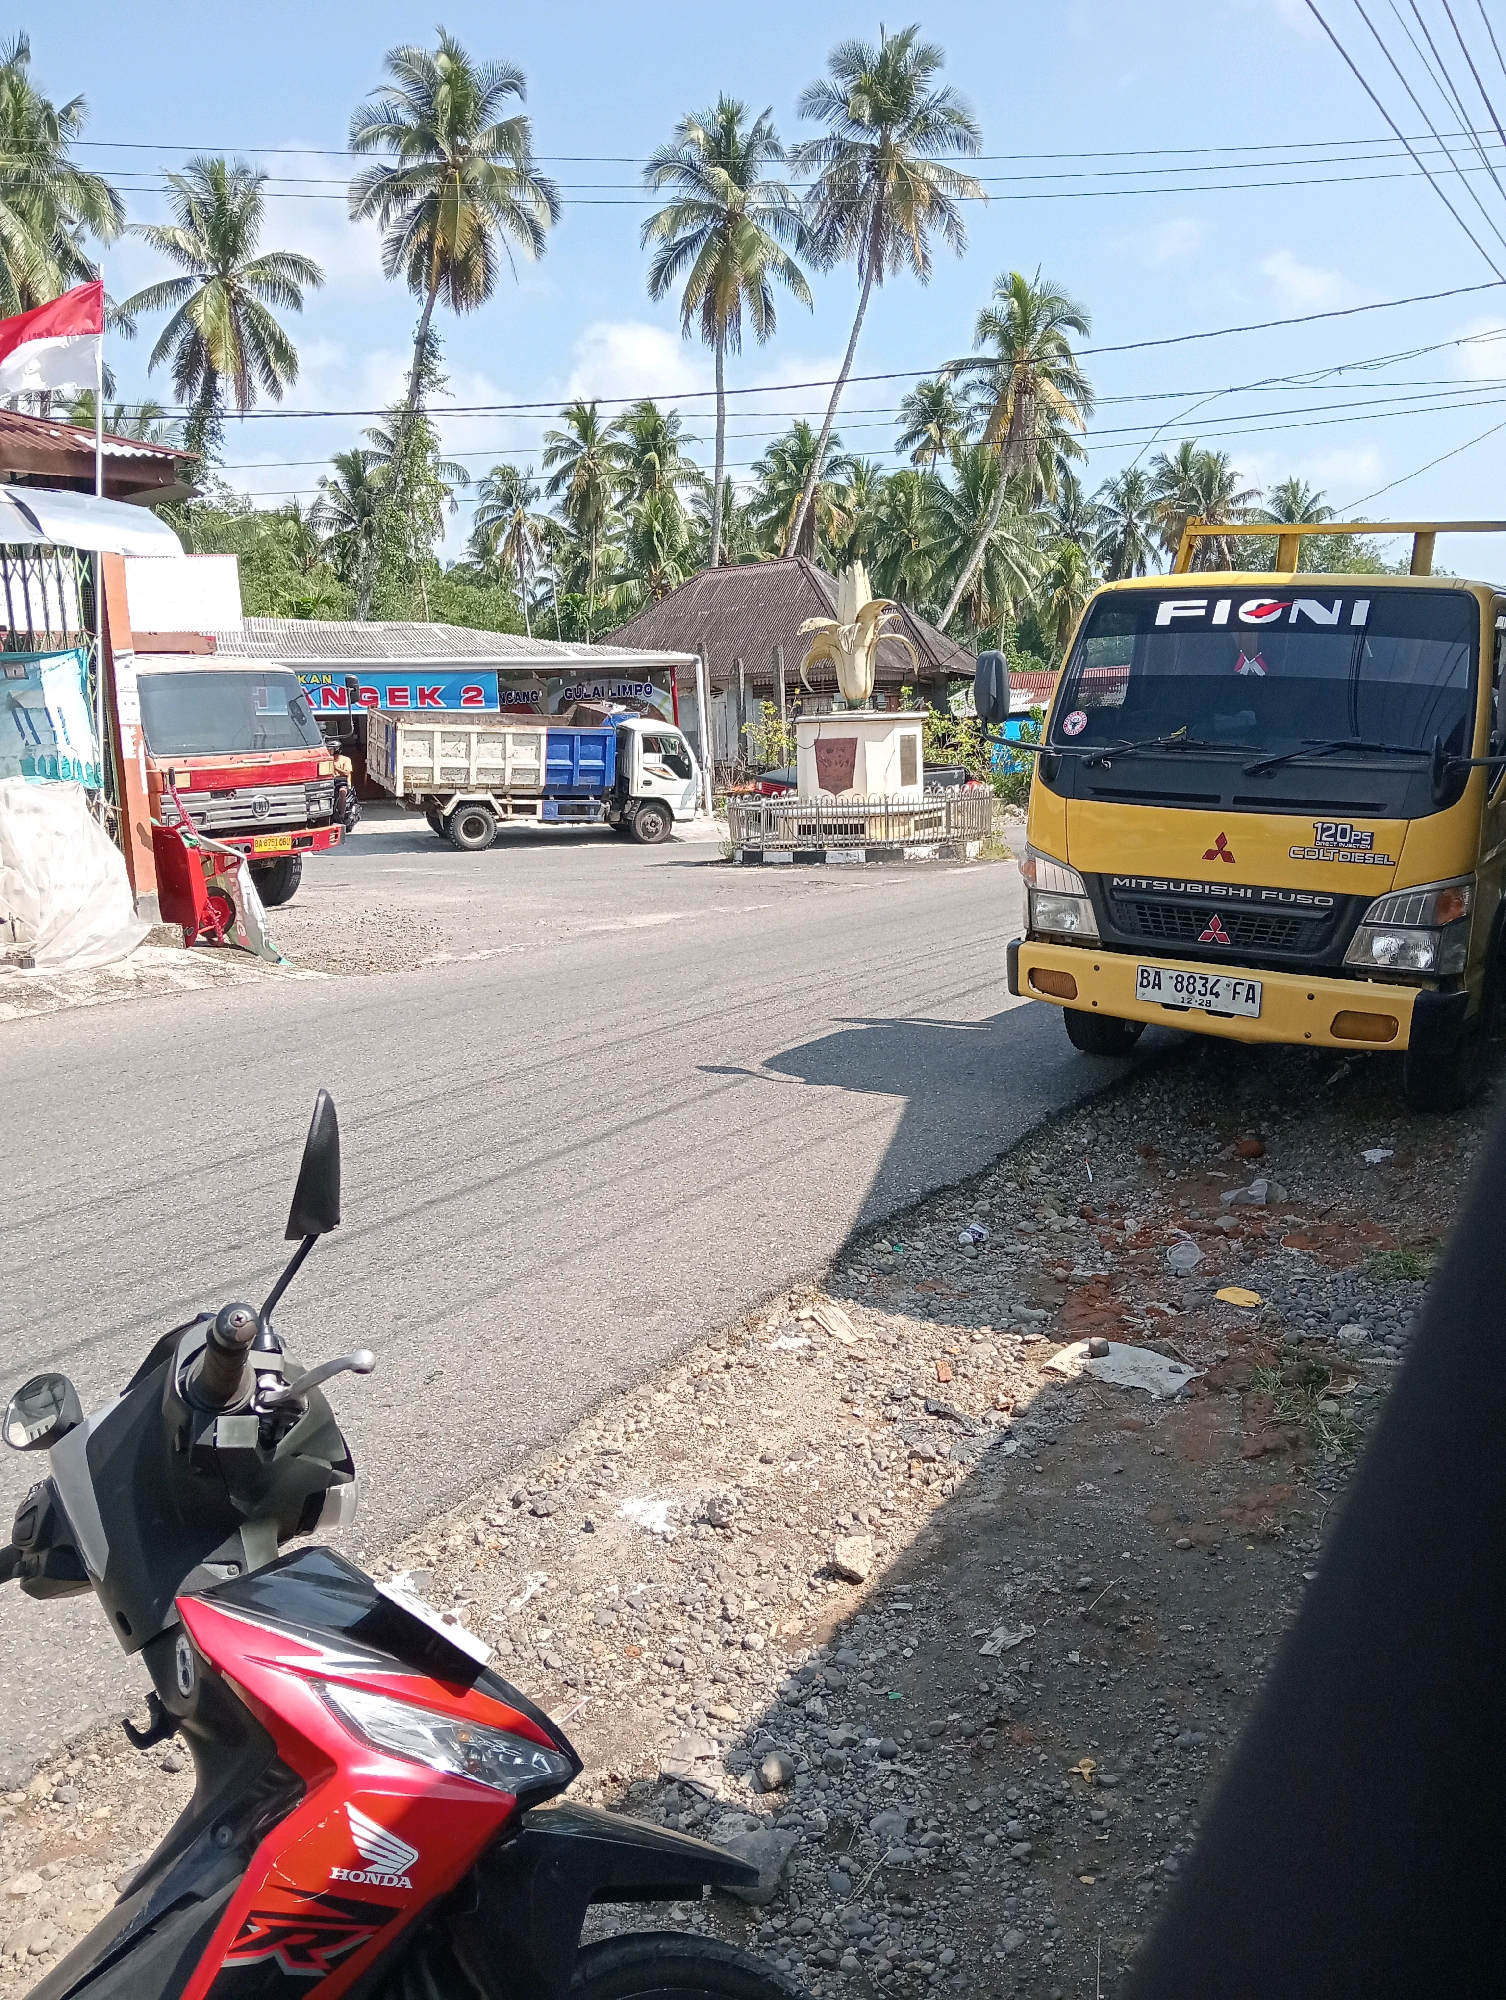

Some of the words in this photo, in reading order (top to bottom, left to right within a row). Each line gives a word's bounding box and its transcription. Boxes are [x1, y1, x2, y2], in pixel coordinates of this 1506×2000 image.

[1155, 598, 1371, 626] FIONI
[460, 685, 486, 708] 2
[564, 685, 605, 700] GULAI
[609, 683, 653, 698] LIMPO
[1112, 877, 1252, 898] MITSUBISHI
[1261, 890, 1334, 906] FUSO
[1139, 968, 1162, 990] BA
[1173, 973, 1221, 998] 8834
[1231, 981, 1256, 1004] FA
[329, 1866, 413, 1889] HONDA
